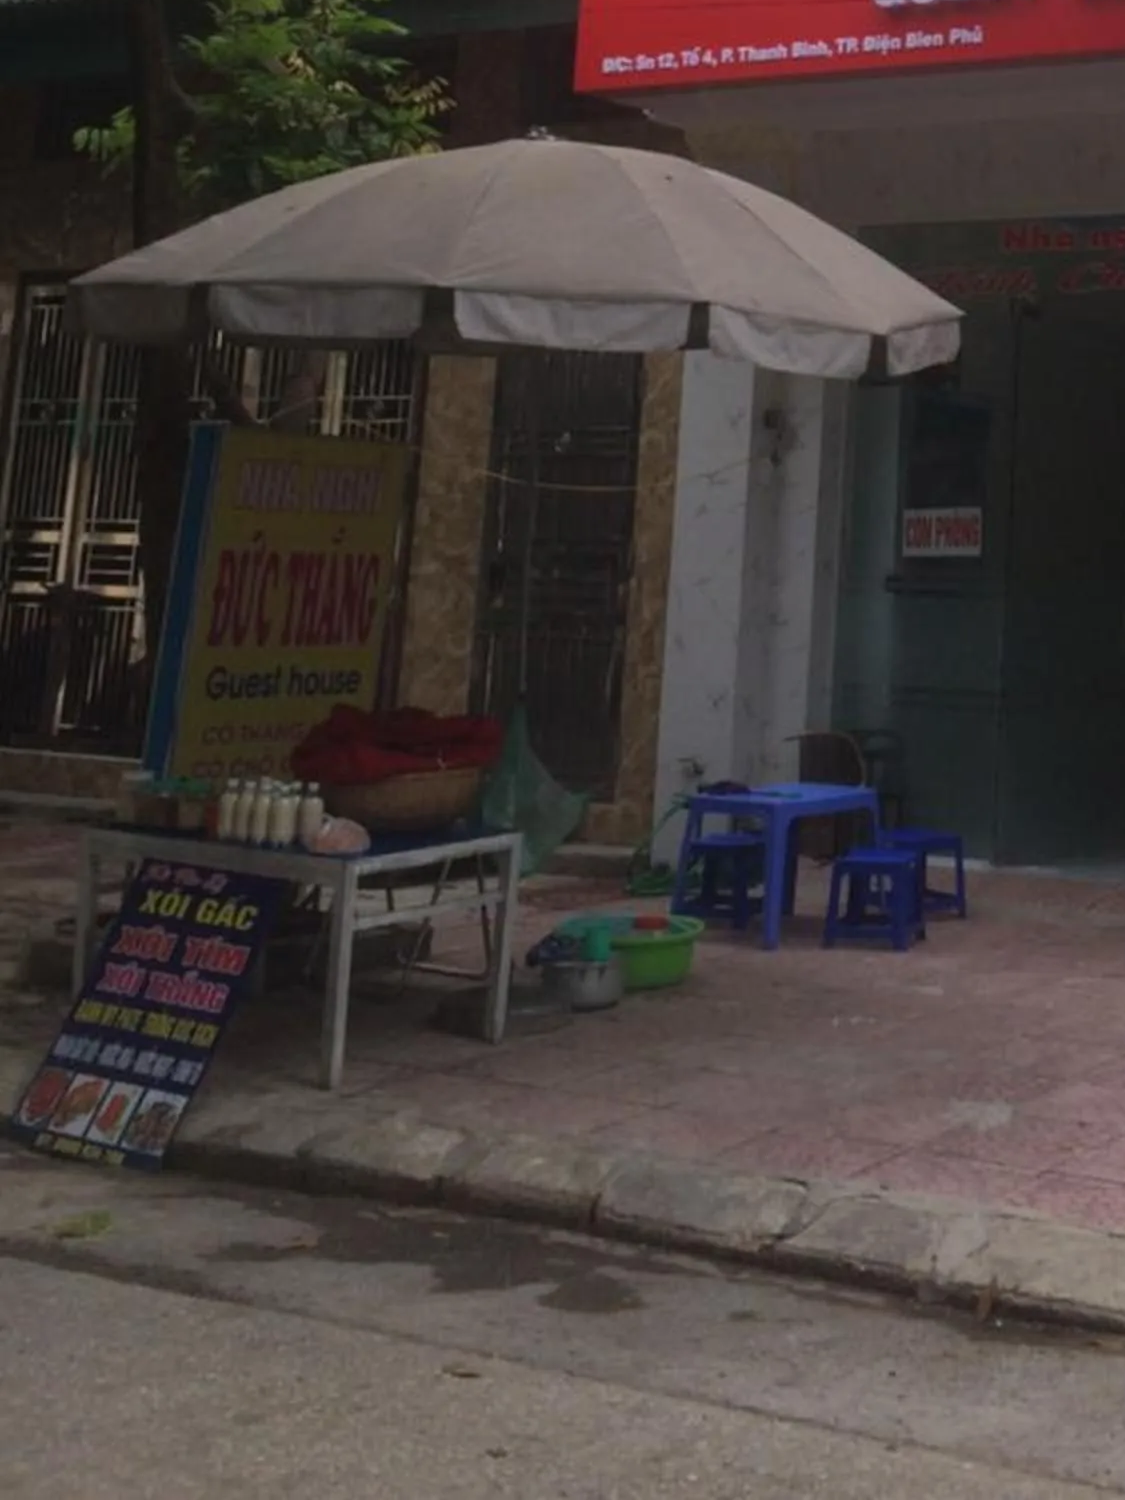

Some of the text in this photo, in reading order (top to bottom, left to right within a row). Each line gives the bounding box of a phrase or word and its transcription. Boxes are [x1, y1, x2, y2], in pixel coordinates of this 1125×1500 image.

[737, 43, 788, 62] Thanh
[207, 529, 279, 647] ĐỨC
[205, 664, 363, 701] Guest house
[138, 886, 193, 920] XÔI
